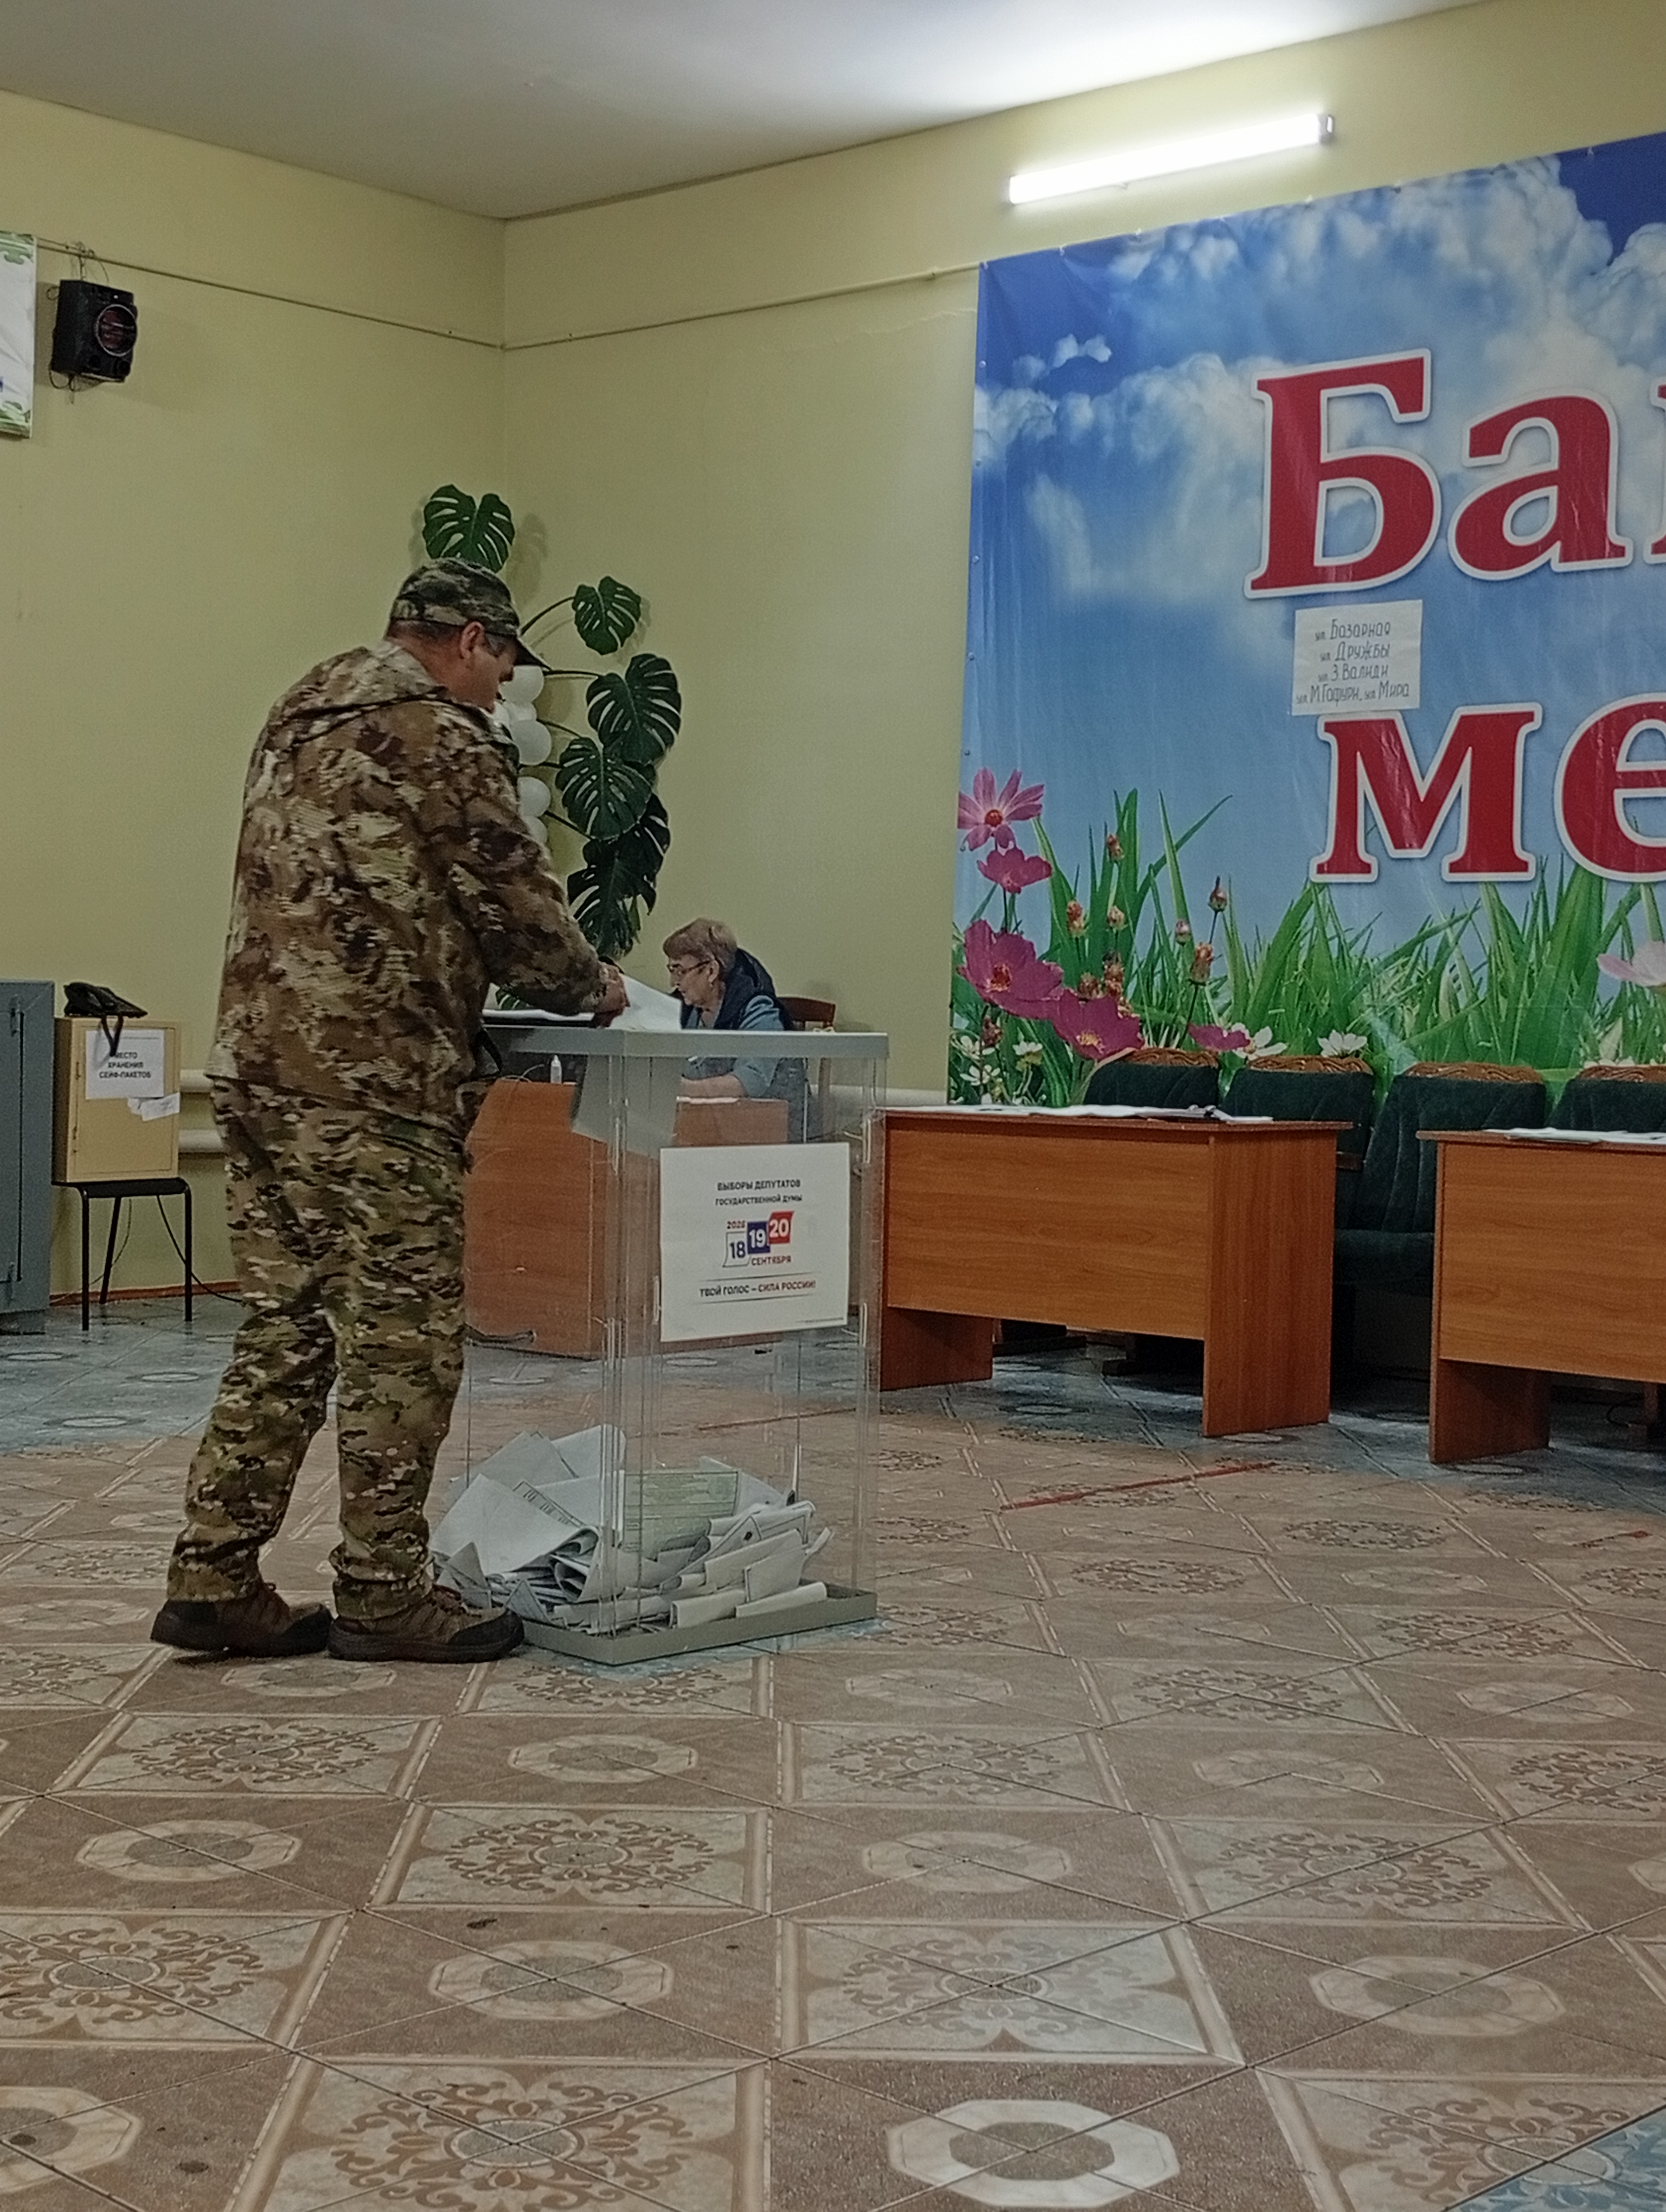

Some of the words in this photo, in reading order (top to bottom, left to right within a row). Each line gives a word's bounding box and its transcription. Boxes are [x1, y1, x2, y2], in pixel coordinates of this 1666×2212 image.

[1245, 349, 1666, 599] Ба
[1330, 618, 1391, 639] Базарная
[1335, 641, 1390, 661] Дружбы
[1378, 680, 1409, 699] Мира
[717, 1180, 753, 1191] ВЫБОРЫ
[754, 1179, 801, 1191] ДЕПУТАТОВ
[715, 1194, 781, 1206] ГОСУДАРСТВЕННОЙ
[783, 1194, 803, 1203] ДУМЫ
[729, 1240, 746, 1259] 18
[749, 1229, 766, 1249] 19
[769, 1218, 790, 1238] 20
[751, 1256, 792, 1266] СЕНТЯБРЯ
[700, 1285, 721, 1297] ТВОЙ
[723, 1284, 749, 1296] ГОЛОС
[758, 1282, 780, 1293] СИЛА
